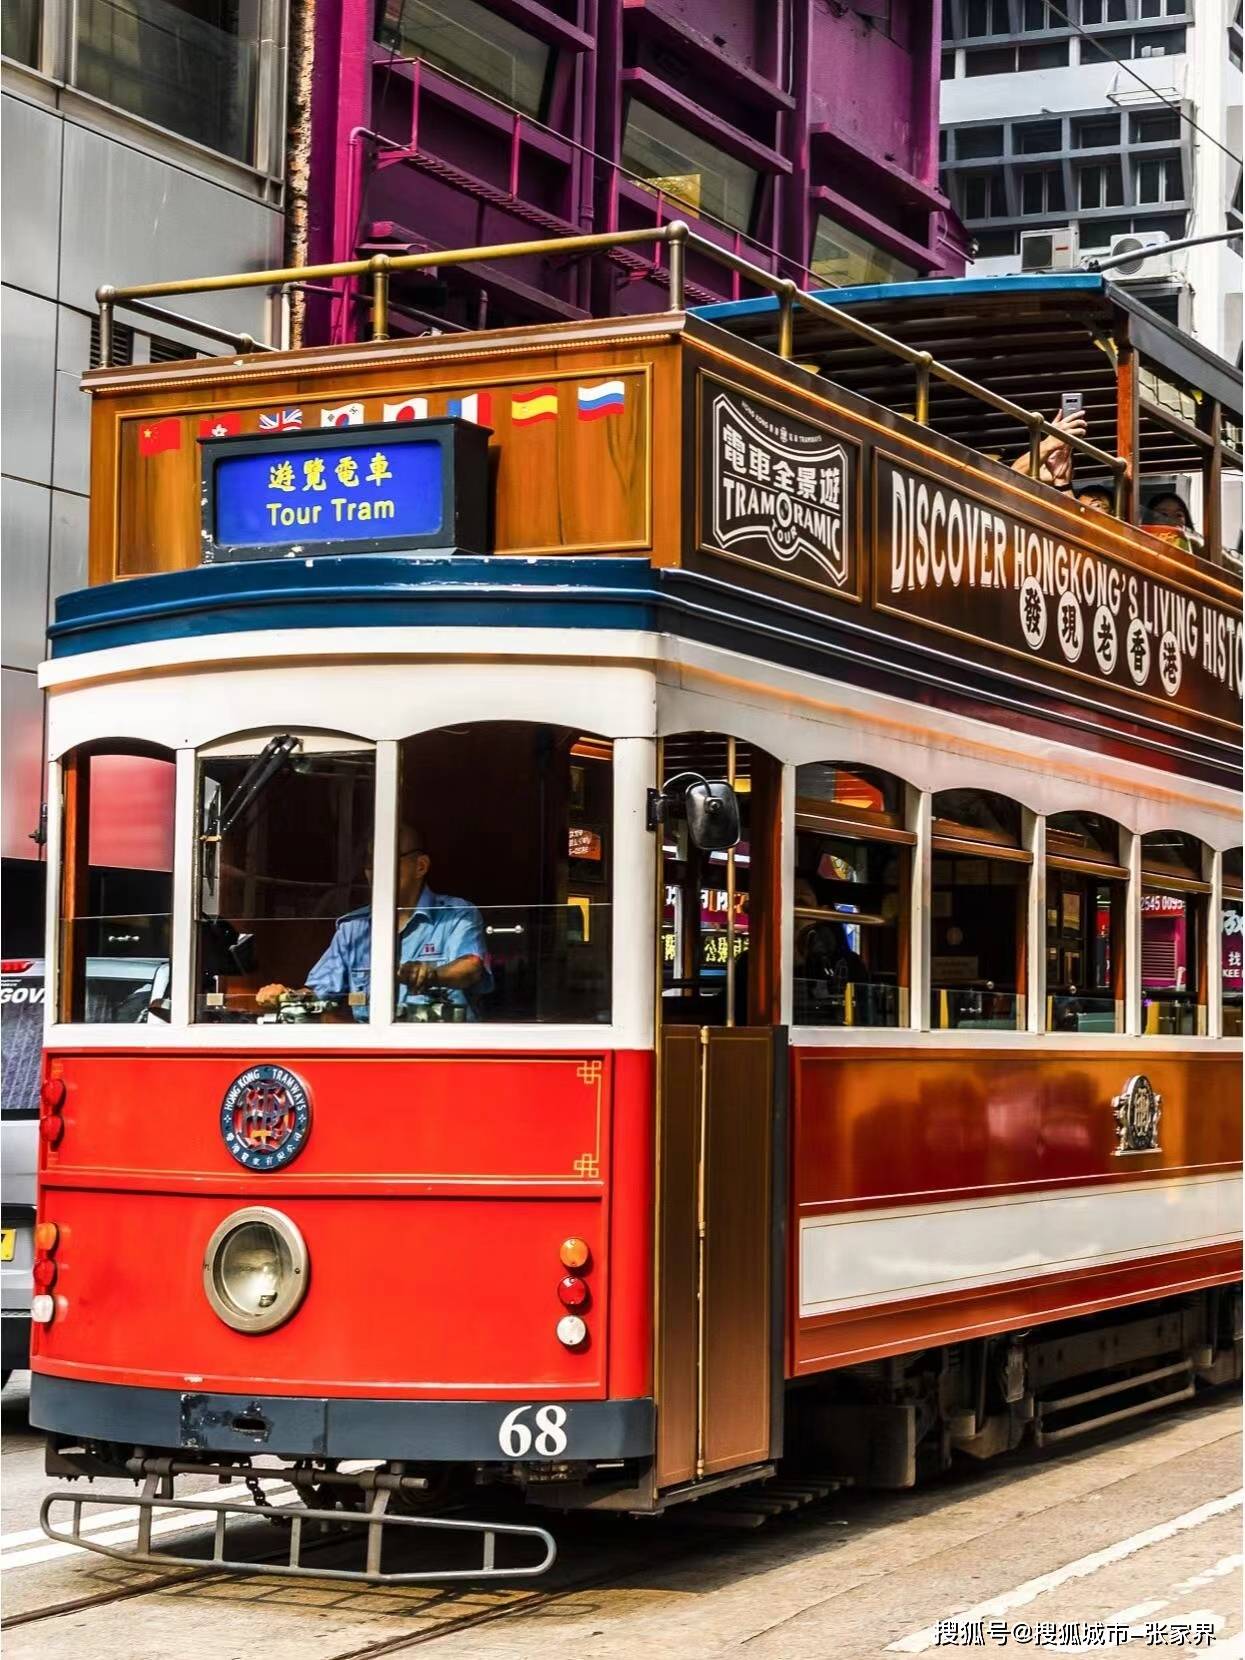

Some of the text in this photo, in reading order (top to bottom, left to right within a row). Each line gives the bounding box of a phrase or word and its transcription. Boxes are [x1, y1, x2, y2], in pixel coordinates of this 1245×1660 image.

[268, 452, 393, 492] 遊覽電車
[723, 423, 840, 511] 電車全景遊
[266, 498, 395, 527] Tour Tram
[722, 477, 841, 561] TRAMORAMIC
[771, 519, 798, 544] TOUR
[891, 470, 1007, 593] DISCOVER
[1143, 580, 1198, 660] LIVING
[1022, 586, 1180, 686] 發現老香港
[223, 1068, 307, 1111] HONG KONG TRAMWAYS
[499, 1404, 568, 1458] 68
